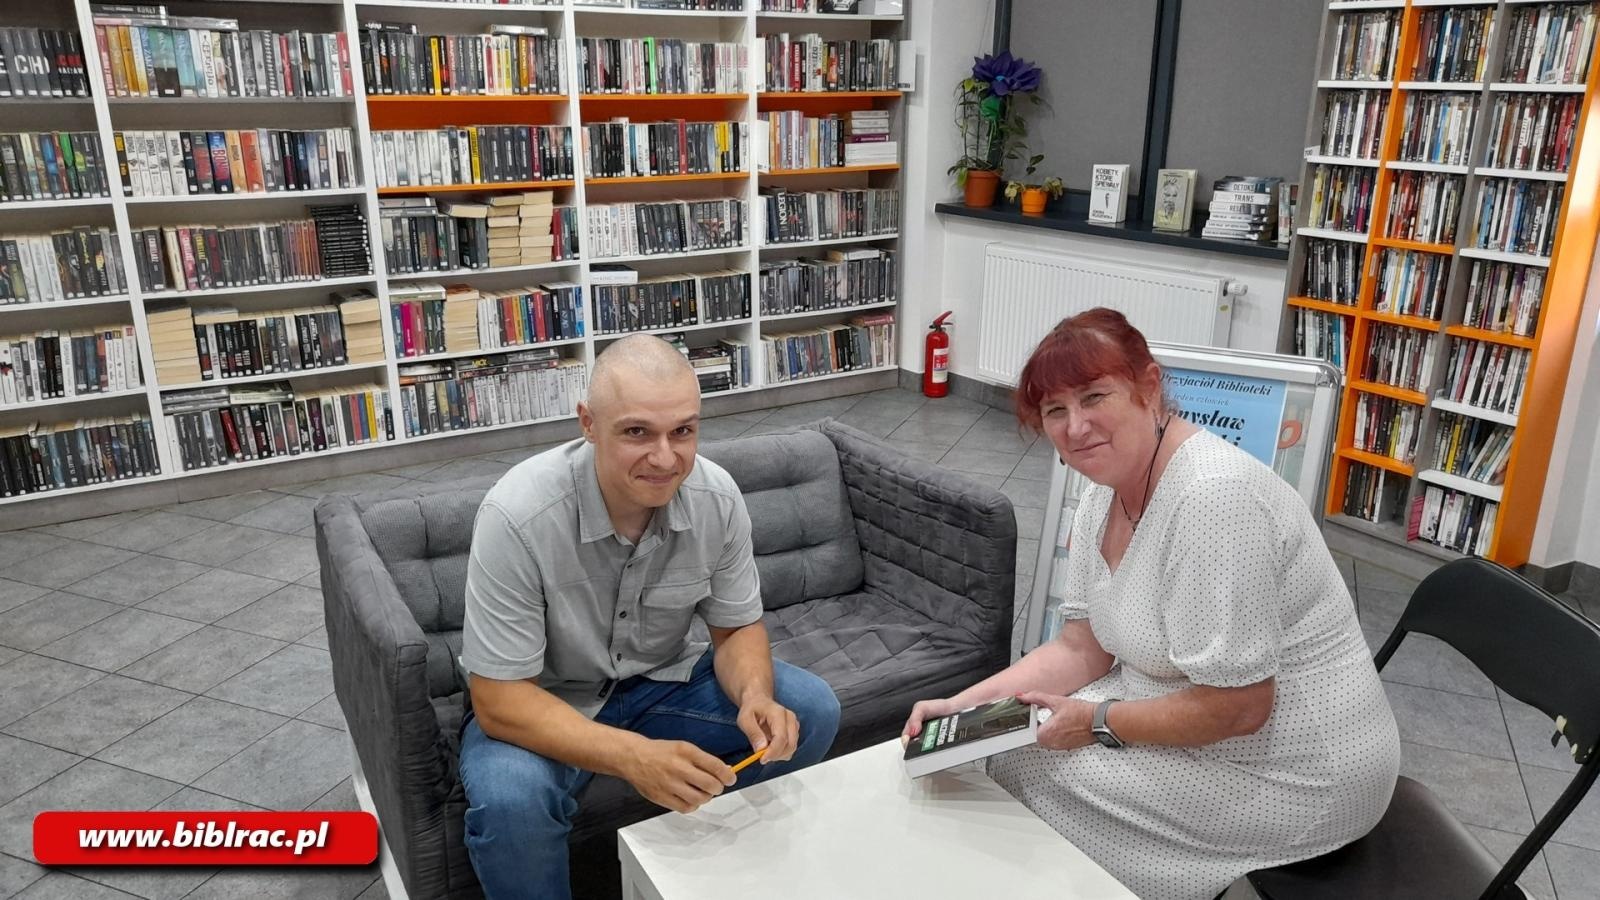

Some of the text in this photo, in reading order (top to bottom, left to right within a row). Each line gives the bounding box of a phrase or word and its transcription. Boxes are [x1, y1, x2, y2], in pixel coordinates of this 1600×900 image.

[777, 192, 788, 225] LEGION
[1234, 194, 1255, 202] TRANS
[1161, 373, 1272, 396] Przyjaciół Biblioteki
